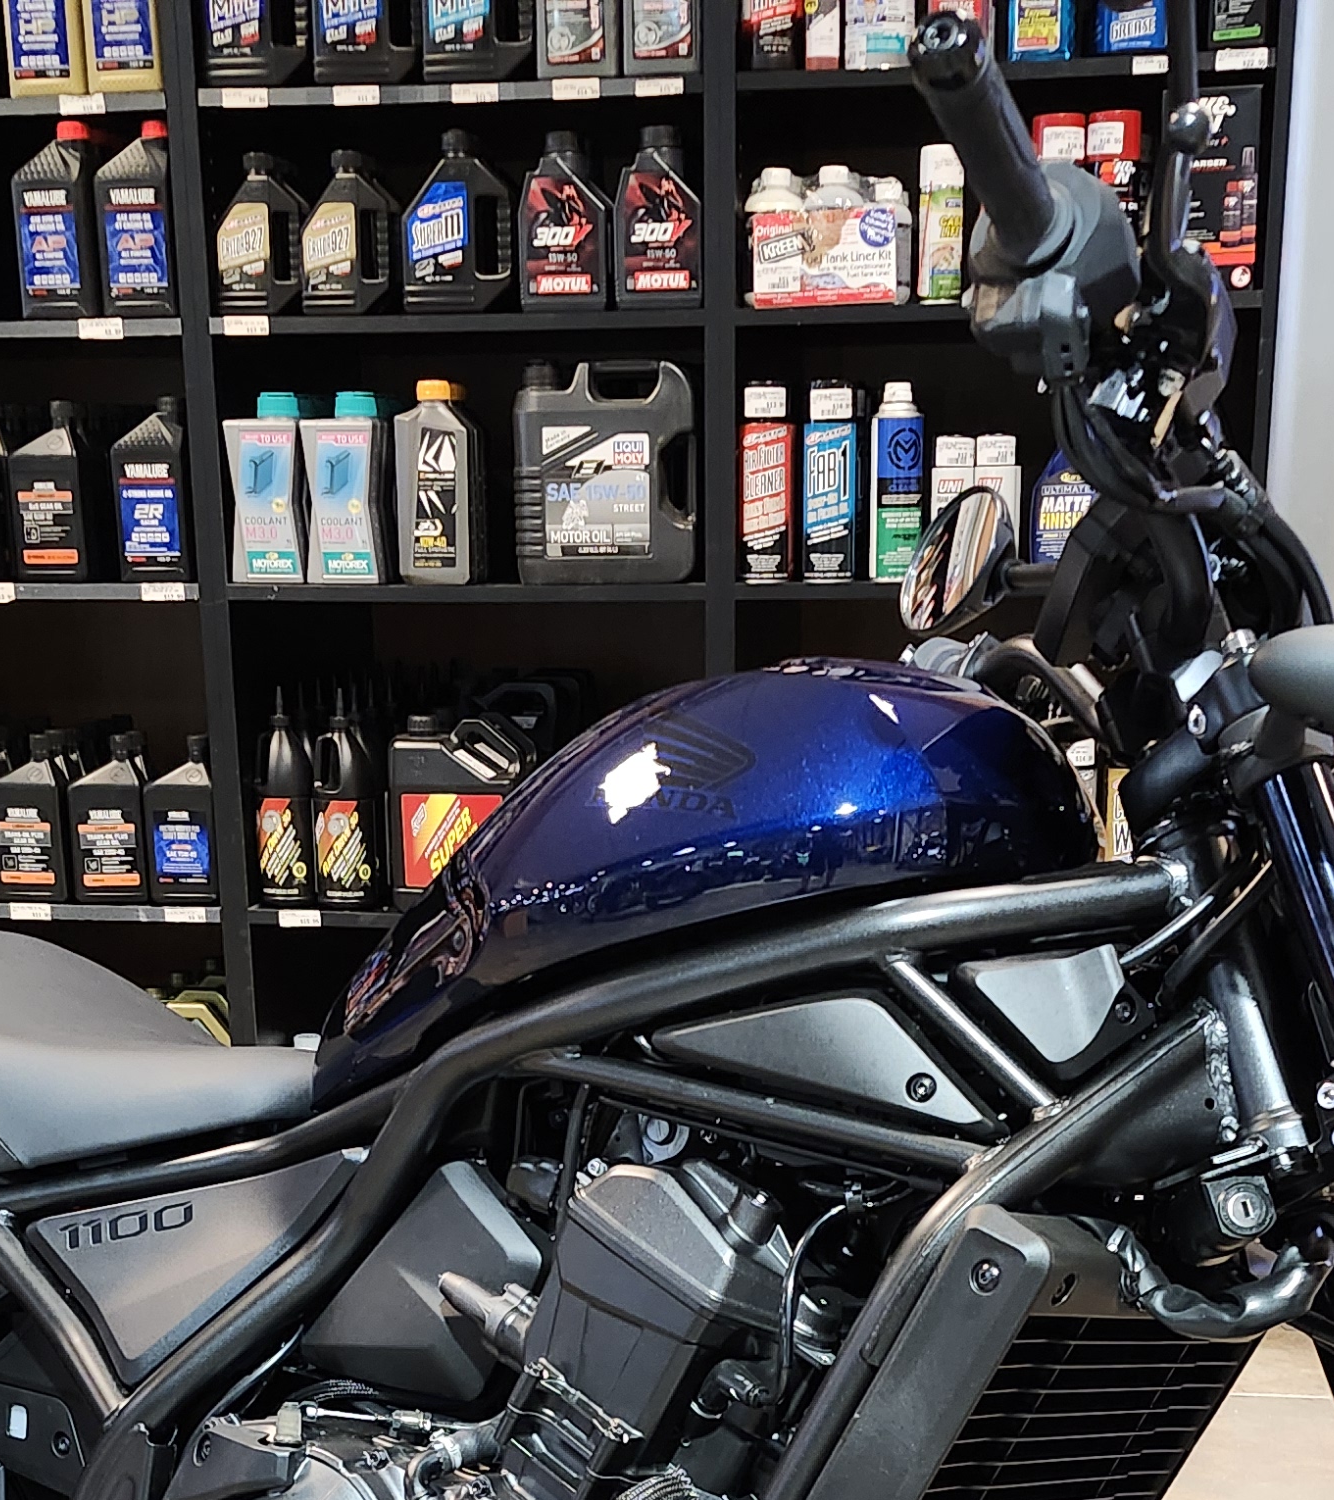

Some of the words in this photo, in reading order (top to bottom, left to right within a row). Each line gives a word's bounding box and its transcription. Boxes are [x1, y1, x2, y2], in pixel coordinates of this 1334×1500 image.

[1110, 17, 1157, 42] GREASE
[533, 221, 594, 247] 300V
[630, 219, 692, 244] 300V
[756, 224, 793, 237] Original
[825, 251, 848, 264] Tank
[850, 250, 876, 262] Liner
[878, 250, 892, 261] Kit
[539, 276, 591, 293] MOTUL
[635, 272, 689, 289] MOTUL
[261, 434, 273, 444] TO
[273, 434, 288, 444] USE
[337, 434, 349, 444] TO
[349, 434, 364, 444] USE
[613, 441, 644, 453] LIQUI
[614, 453, 644, 464] MOLY
[124, 463, 170, 478] YAMALUBE
[744, 467, 786, 501] CLEANER
[938, 479, 964, 493] UNI
[978, 477, 1003, 492] UNI
[546, 482, 581, 502] SAE
[613, 504, 645, 513] STREET
[1040, 495, 1093, 513] MATTE
[134, 504, 164, 519] 2R
[244, 516, 288, 526] COOLANT
[320, 516, 364, 526] COOLANT
[1039, 512, 1085, 530] FINISH
[245, 526, 278, 540] M3.0
[321, 526, 354, 540] M3.0
[550, 530, 590, 544] MOTOR
[591, 530, 611, 543] OIL
[252, 557, 293, 569] MOTOREX
[328, 557, 369, 569] MOTOREX
[429, 806, 472, 878] SUPER
[58, 1200, 194, 1250] 1100
